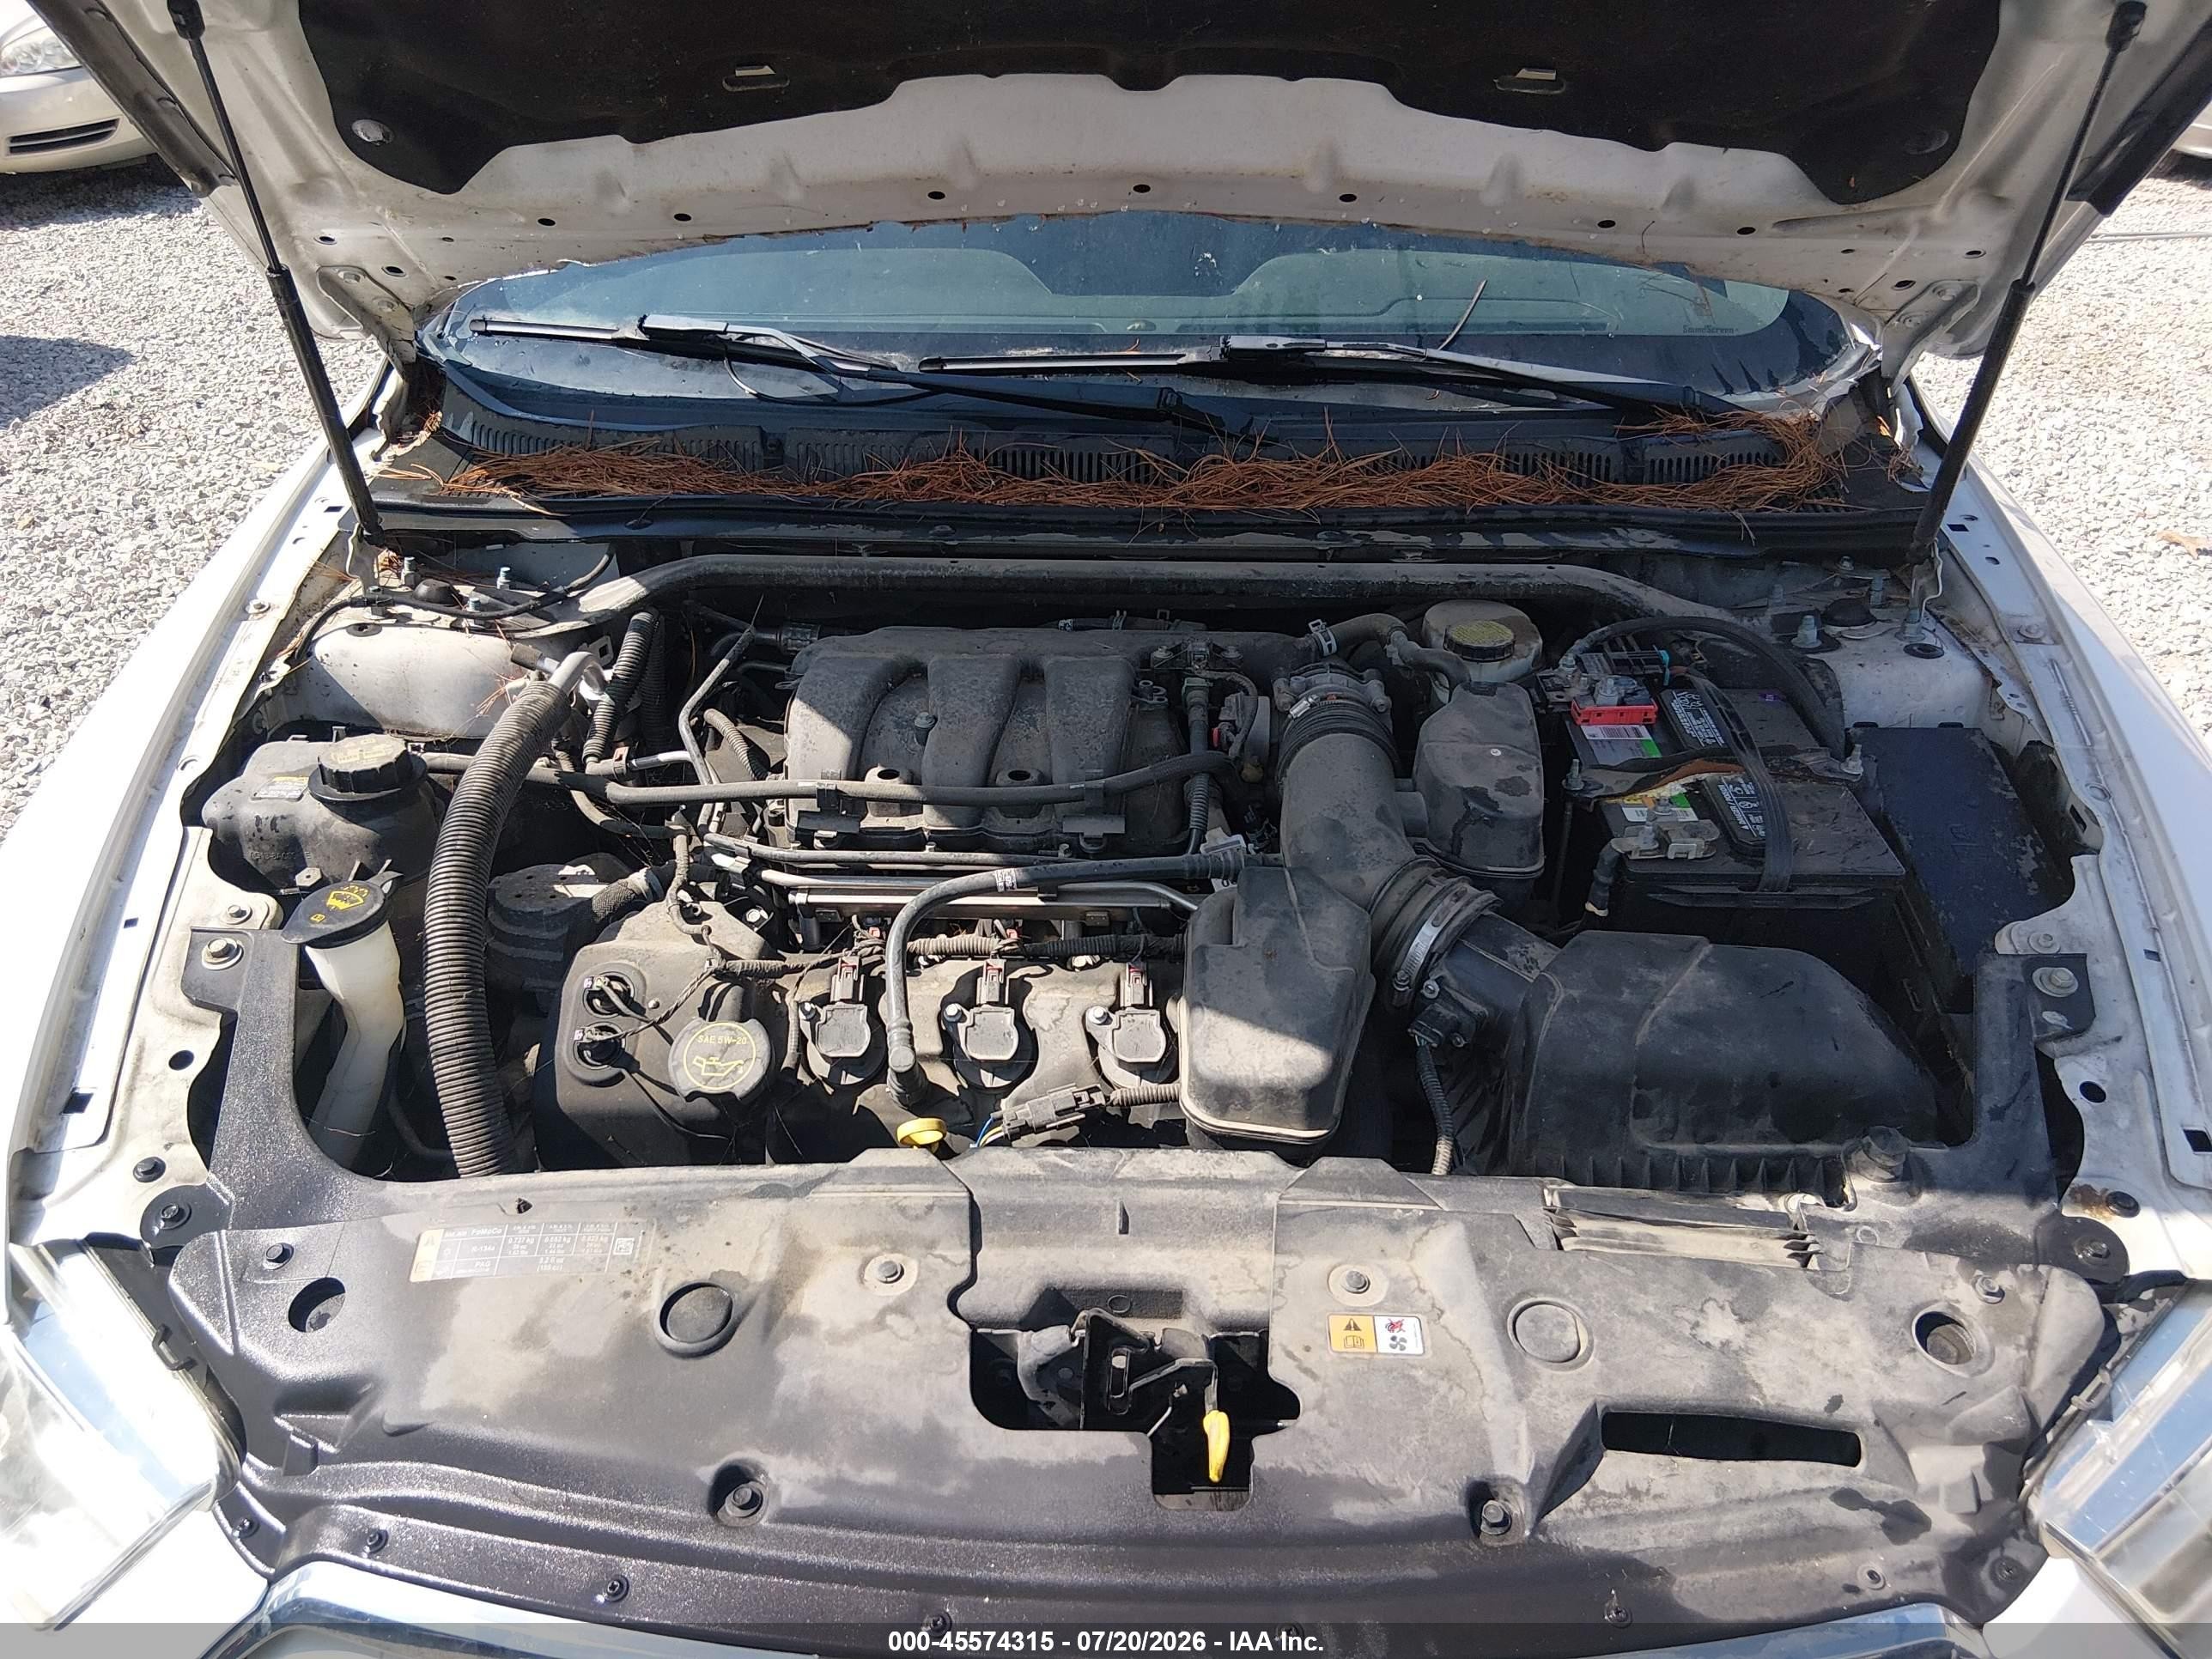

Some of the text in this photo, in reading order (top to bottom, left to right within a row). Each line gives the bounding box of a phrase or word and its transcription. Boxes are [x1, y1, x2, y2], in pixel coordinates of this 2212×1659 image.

[697, 1035, 747, 1045] SAE 5W-20
[471, 1227, 503, 1237] FoMoCo
